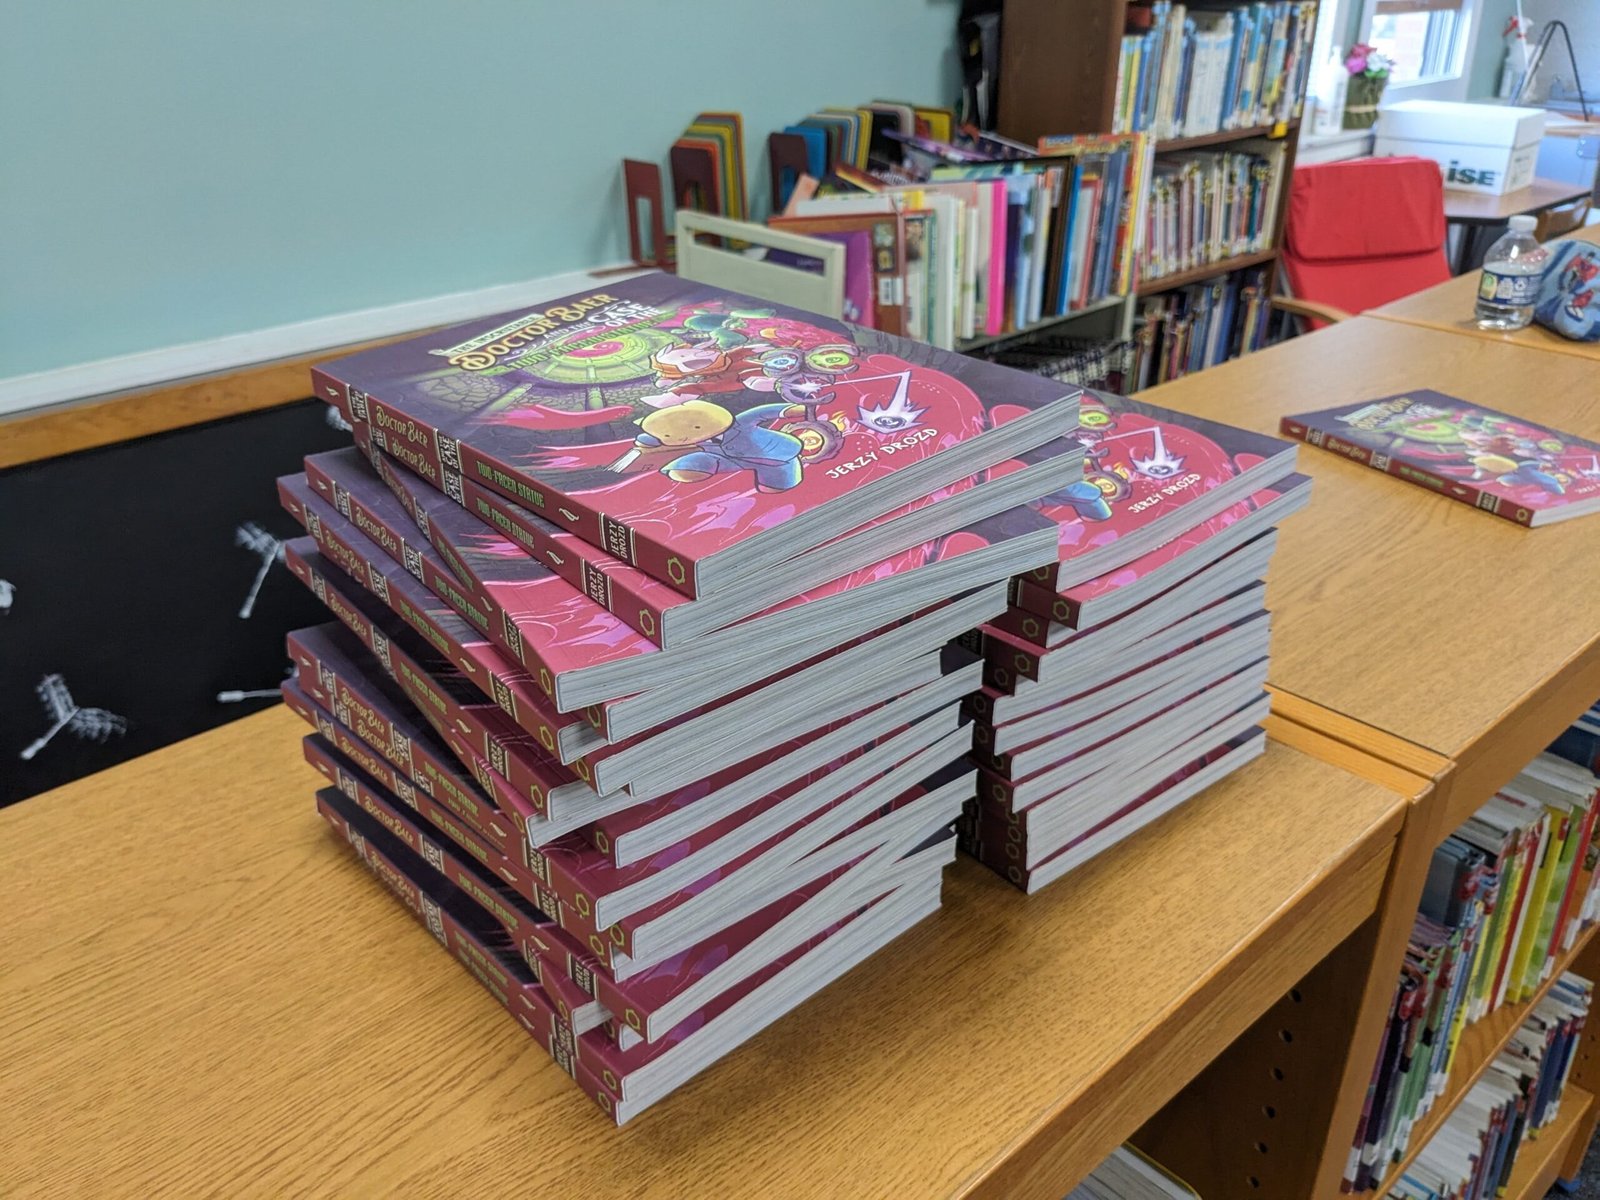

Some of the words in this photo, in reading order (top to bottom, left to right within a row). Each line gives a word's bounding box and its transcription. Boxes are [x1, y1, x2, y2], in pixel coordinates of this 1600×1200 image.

[588, 301, 645, 324] CASE
[605, 313, 629, 328] OF
[627, 305, 665, 321] THE
[448, 317, 561, 371] DOCTOR
[544, 294, 619, 323] BAER
[376, 405, 407, 435] DOCTOR
[406, 421, 428, 448] BAER
[391, 437, 418, 468] DOCTOR
[418, 453, 436, 481] BAER
[443, 436, 453, 466] CASE
[825, 451, 879, 479] JERZY
[879, 427, 938, 455] DROZD
[1128, 491, 1164, 514] JERZY
[1162, 473, 1201, 496] DROZD
[609, 520, 619, 556] JERZY
[617, 525, 628, 559] DROZD
[589, 567, 600, 602] JERZY
[597, 572, 606, 606] DROZD
